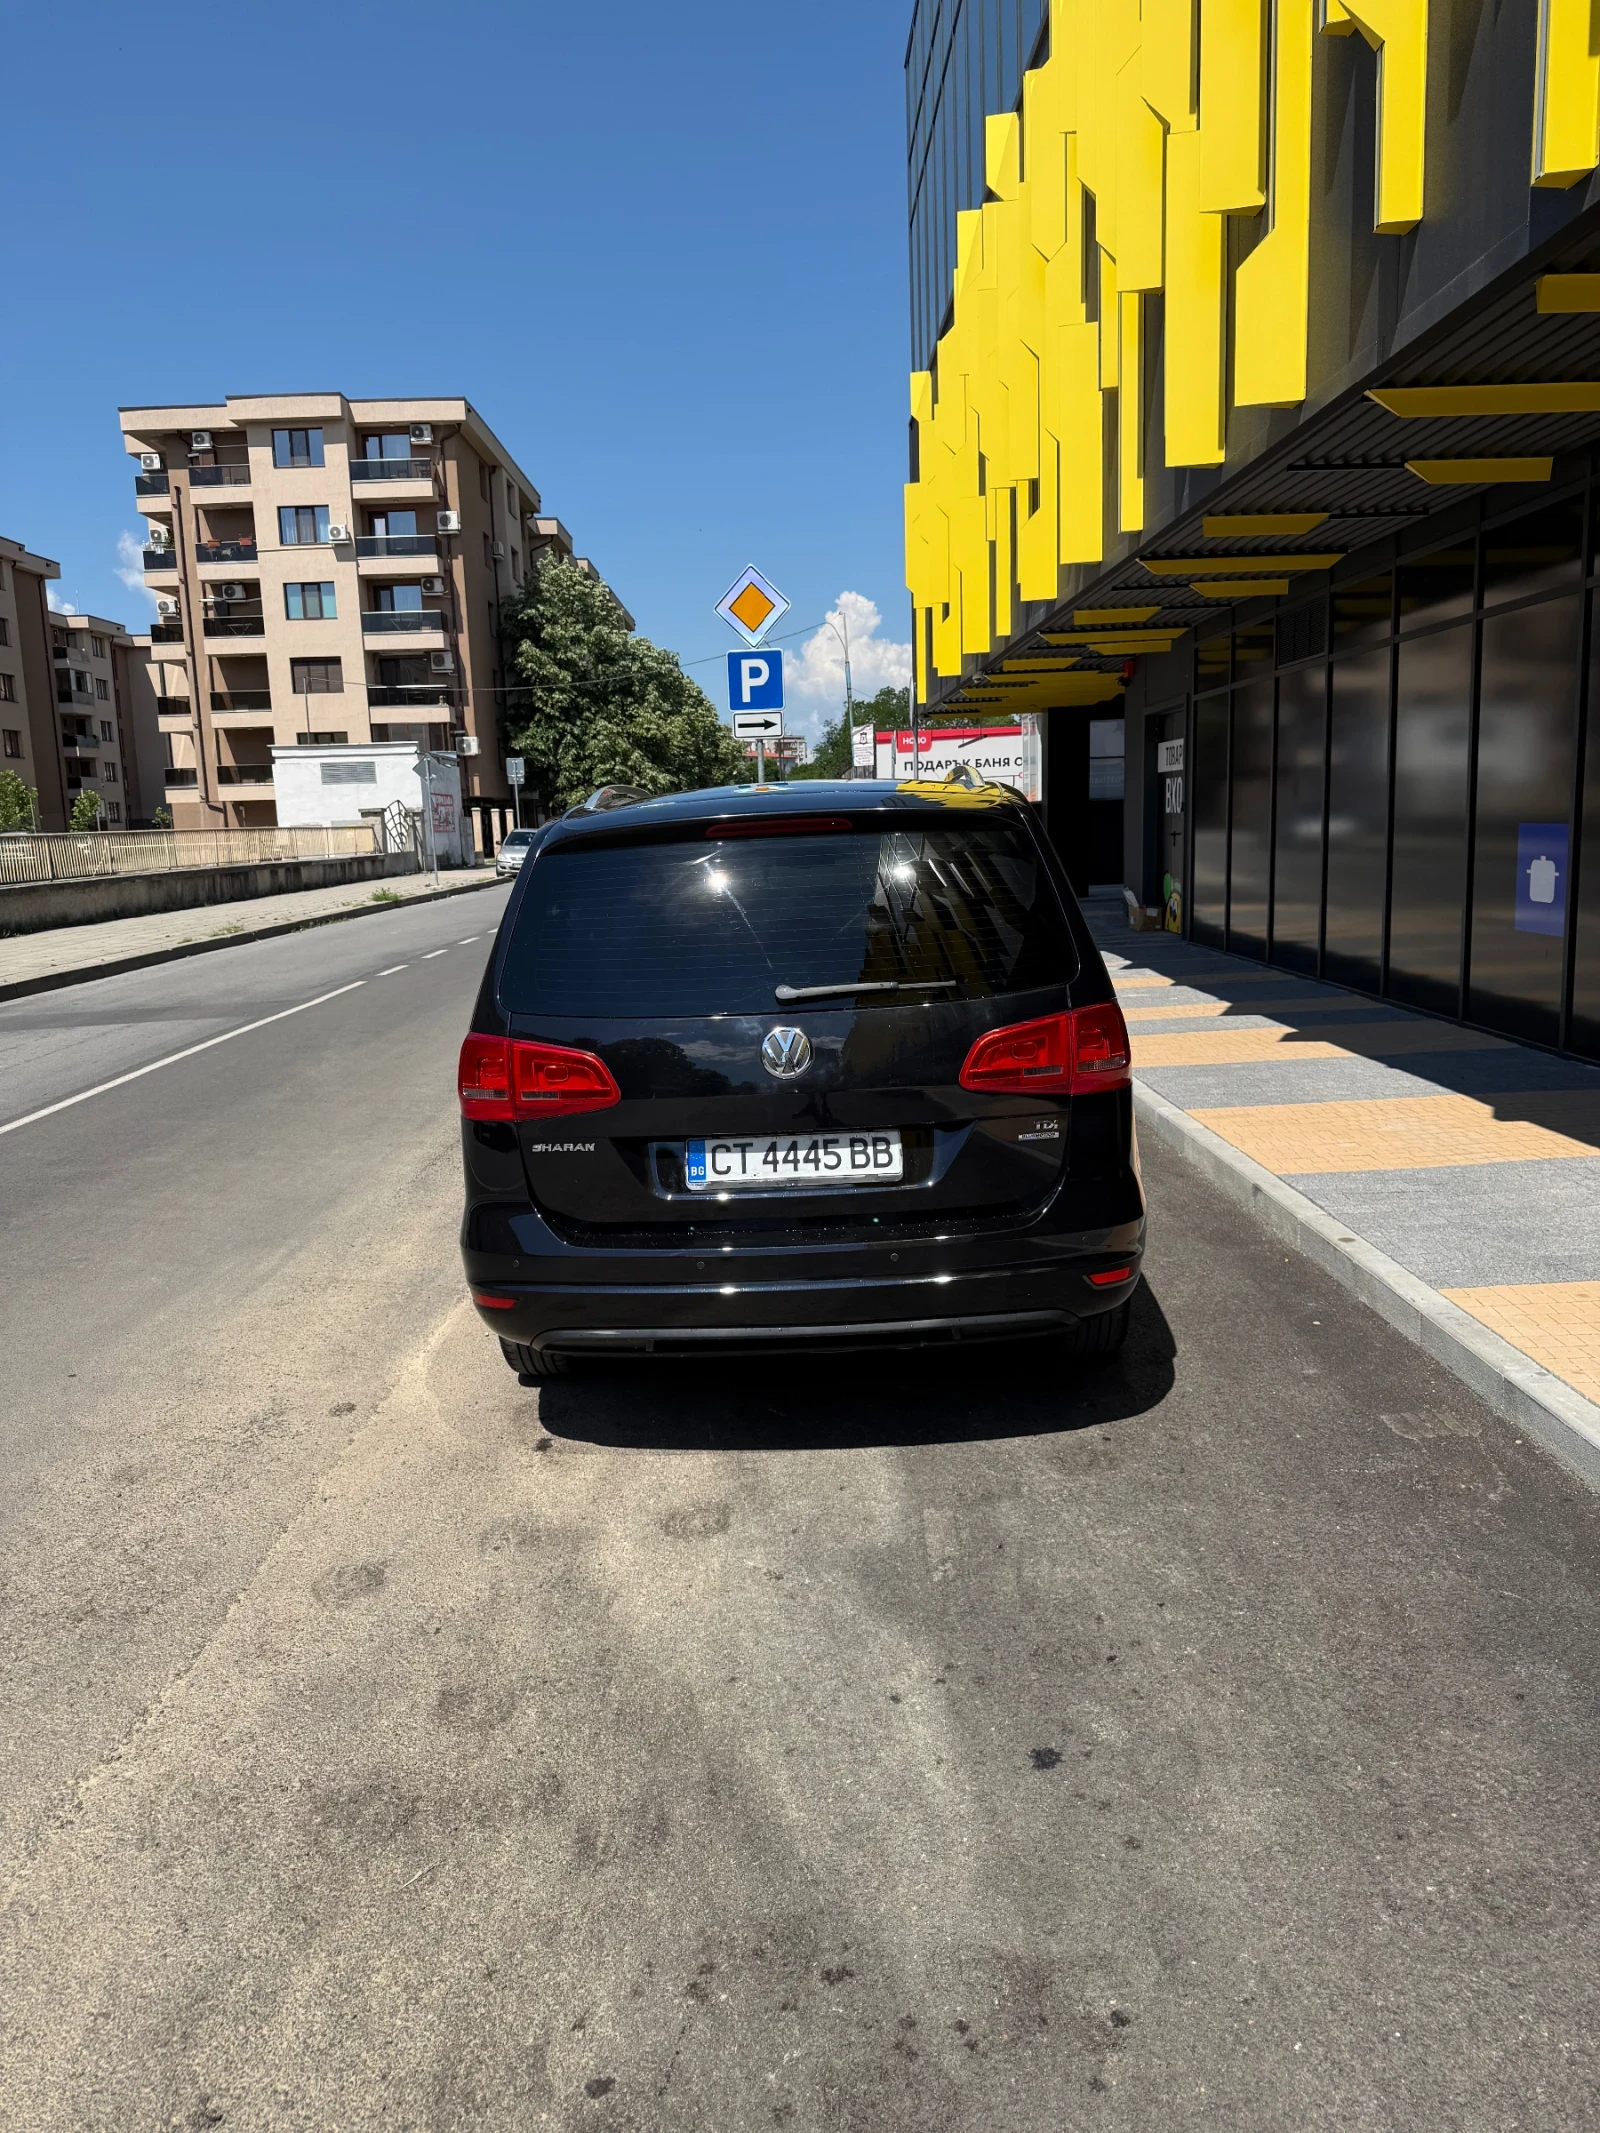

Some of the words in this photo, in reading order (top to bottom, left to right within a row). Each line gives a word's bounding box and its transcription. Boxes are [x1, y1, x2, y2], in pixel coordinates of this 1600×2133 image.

[741, 659, 769, 702] P
[975, 757, 1010, 768] БАНЯ
[532, 1143, 596, 1152] SHARAN
[711, 1142, 754, 1175] CT
[762, 1138, 842, 1173] 4445
[850, 1136, 893, 1170] BB
[691, 1166, 705, 1176] BG
